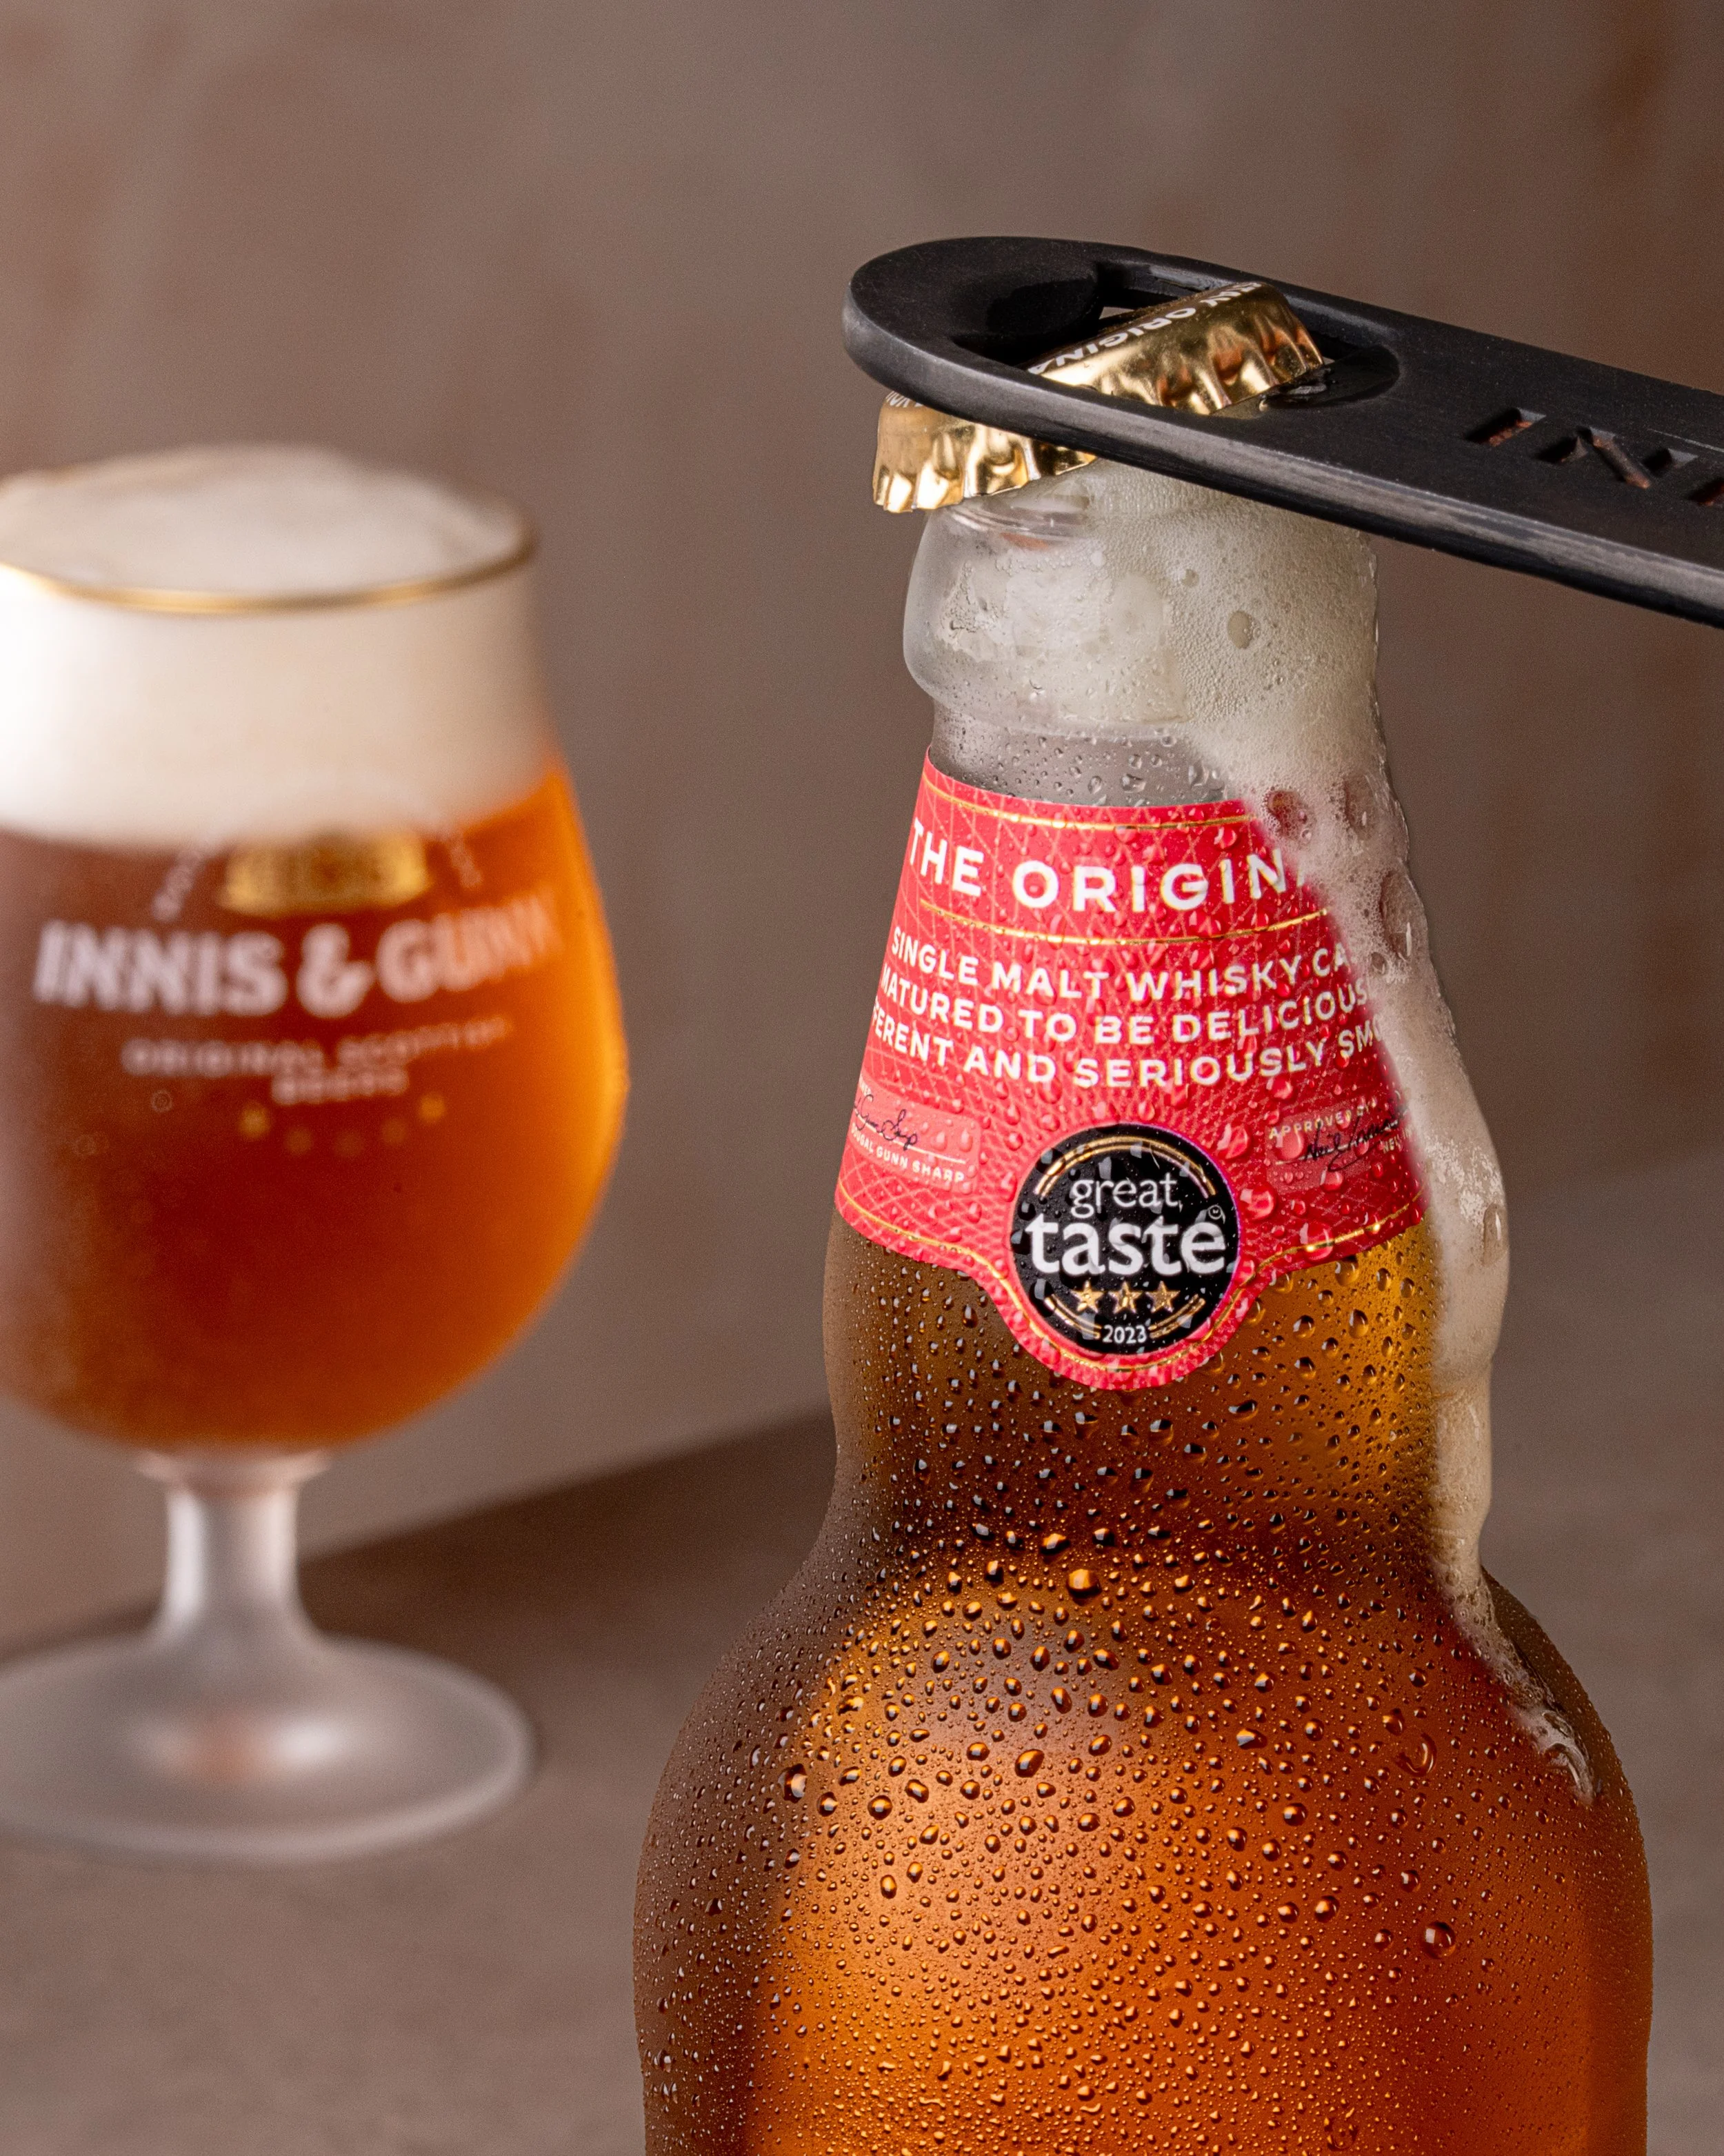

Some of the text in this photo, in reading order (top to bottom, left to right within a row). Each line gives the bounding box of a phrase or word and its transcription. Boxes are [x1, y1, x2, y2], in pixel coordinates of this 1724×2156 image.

[910, 817, 985, 897] THE
[32, 920, 286, 1017] INNIS
[295, 922, 376, 1019] &
[891, 926, 980, 986] SINGLE
[991, 961, 1110, 999] MALT
[1125, 954, 1301, 1002] WHISKY
[881, 962, 1004, 1035] MATURED
[1017, 1008, 1077, 1042] TO
[1094, 1015, 1155, 1045] BE
[963, 1046, 1057, 1084] AND
[1072, 1037, 1327, 1088] SERIOUSLY
[876, 1146, 909, 1170] GUNN
[912, 1159, 965, 1184] SHARP
[1070, 1172, 1180, 1219] great
[1024, 1212, 1227, 1275] taste
[1103, 1324, 1148, 1344] 2023
